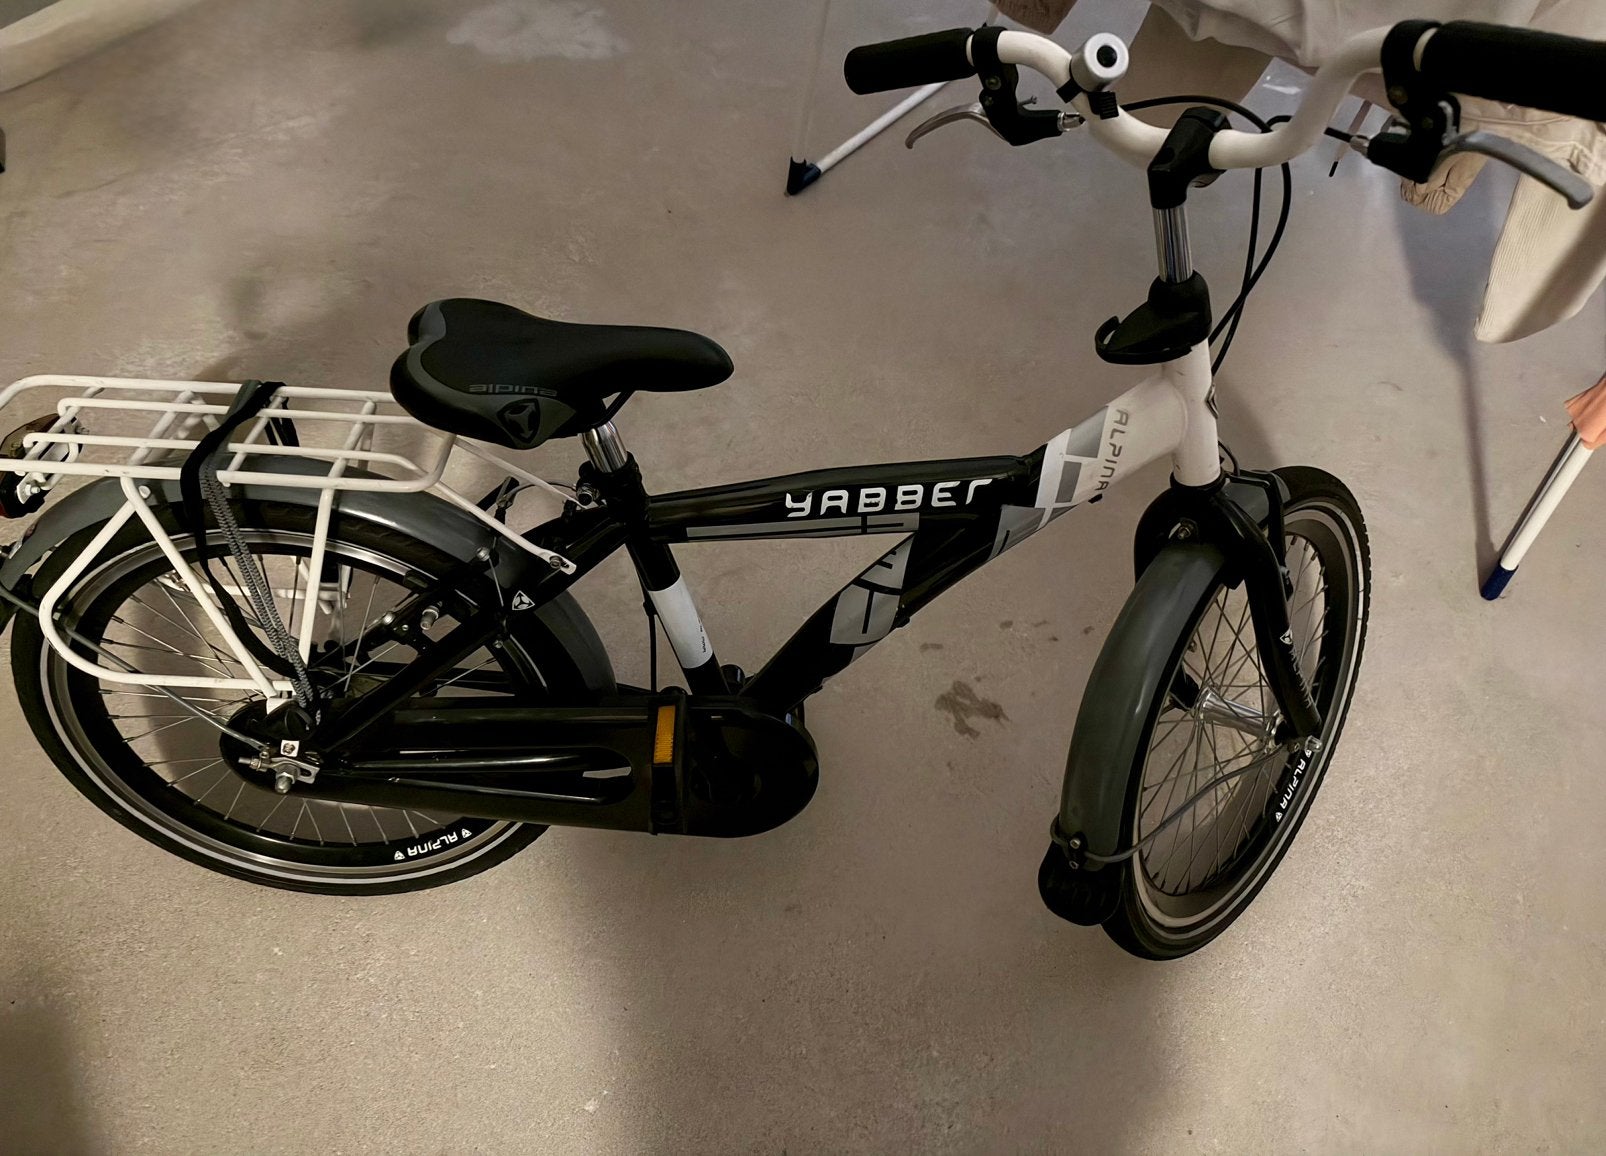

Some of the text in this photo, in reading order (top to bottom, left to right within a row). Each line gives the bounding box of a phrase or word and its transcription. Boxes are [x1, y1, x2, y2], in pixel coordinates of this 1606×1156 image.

[1095, 409, 1129, 491] ALPINA
[1280, 759, 1306, 809] ALPINA
[407, 832, 458, 856] ALPINA
